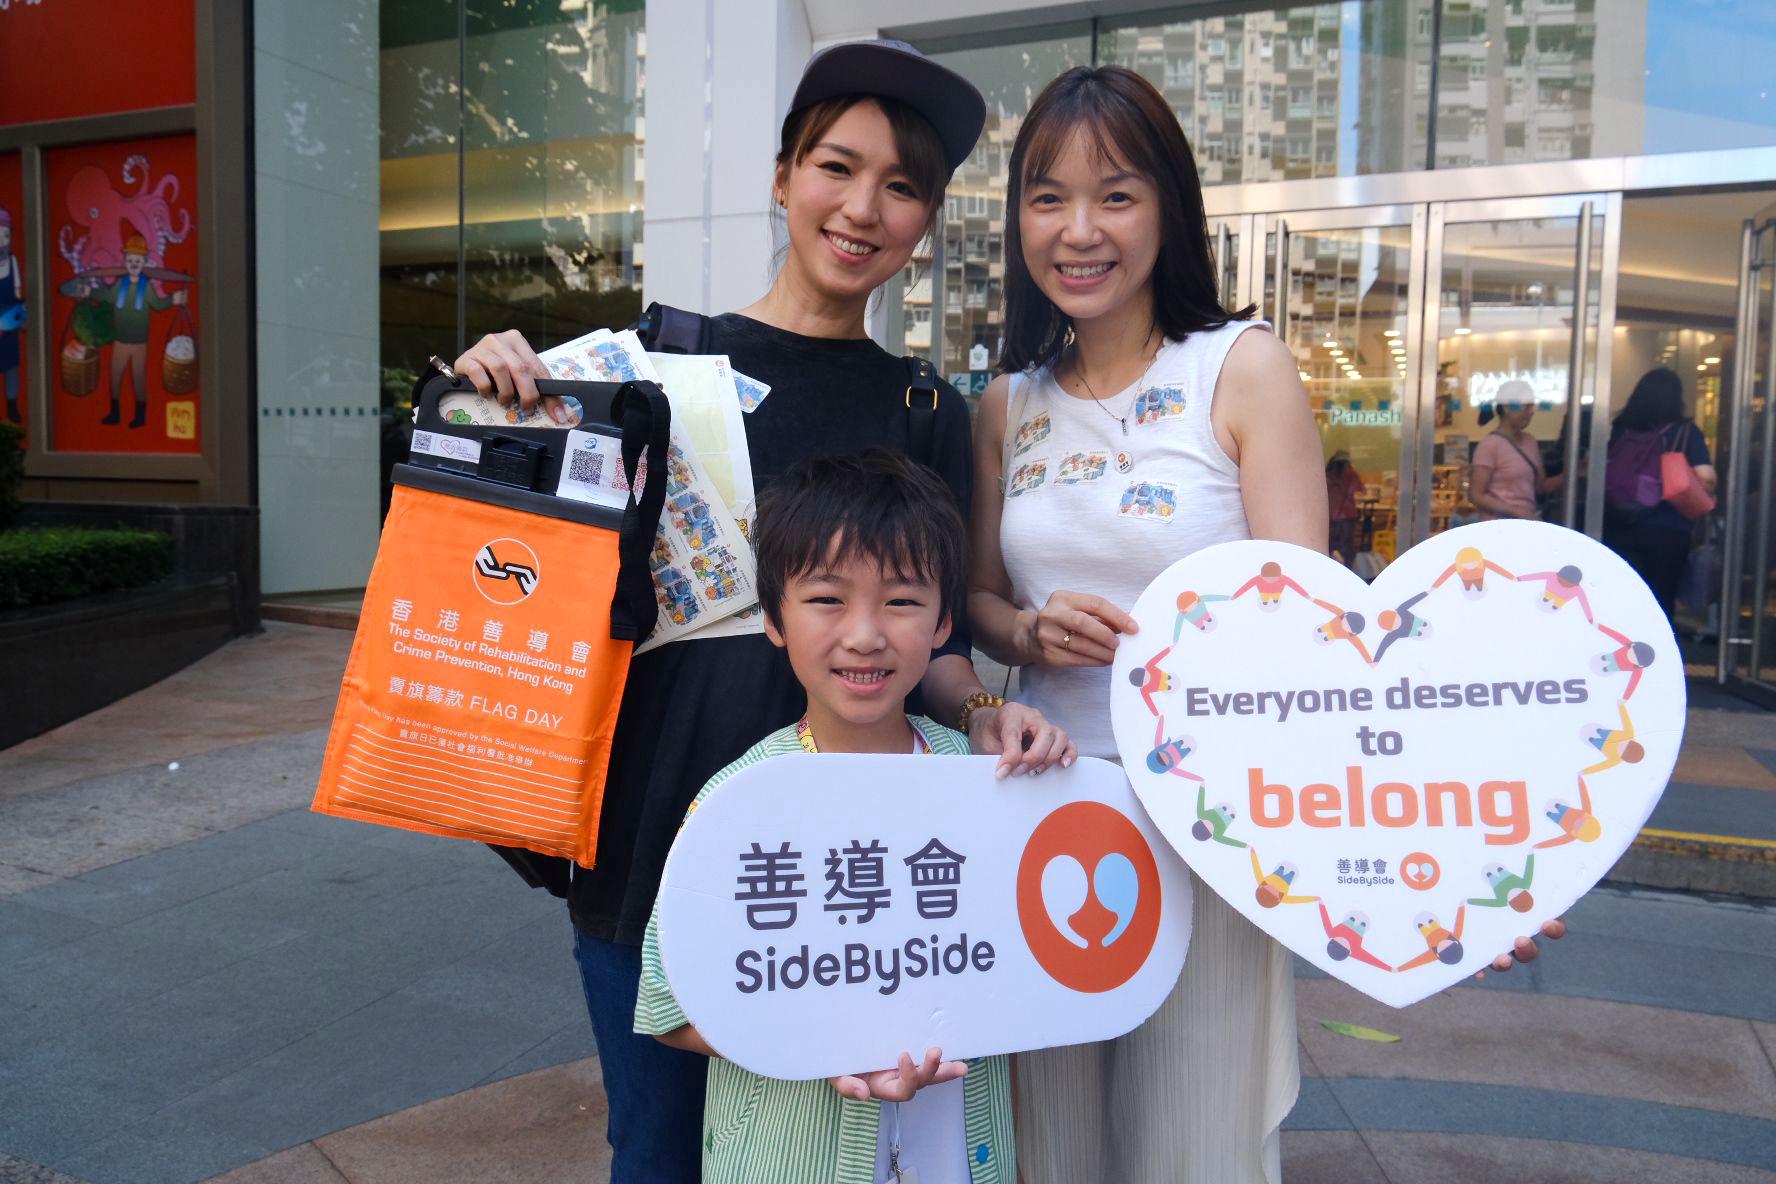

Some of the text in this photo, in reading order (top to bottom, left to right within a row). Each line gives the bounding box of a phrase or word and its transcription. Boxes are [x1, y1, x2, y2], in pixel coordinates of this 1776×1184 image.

[1330, 407, 1402, 425] Panash
[389, 622, 587, 679] The Society of Rehabilitation and
[391, 598, 591, 663] 香港善導會
[393, 641, 573, 694] Crime Prevention, Hong Kong
[387, 676, 564, 729] 賣旗籌款 FLAG DAY
[1186, 677, 1589, 722] Everyone deserves
[382, 713, 394, 722] Day
[395, 716, 410, 725] has
[412, 720, 431, 729] been
[432, 725, 468, 738] approved
[469, 732, 479, 741] by
[481, 735, 493, 743] the
[495, 738, 517, 749] Social
[519, 744, 547, 756] Welfare
[1356, 725, 1403, 756] to
[1248, 765, 1531, 846] belong
[734, 837, 967, 931] 善導會
[1337, 858, 1388, 874] 善導會
[1337, 875, 1395, 887] SideBySide
[735, 932, 996, 996] SideBySide
